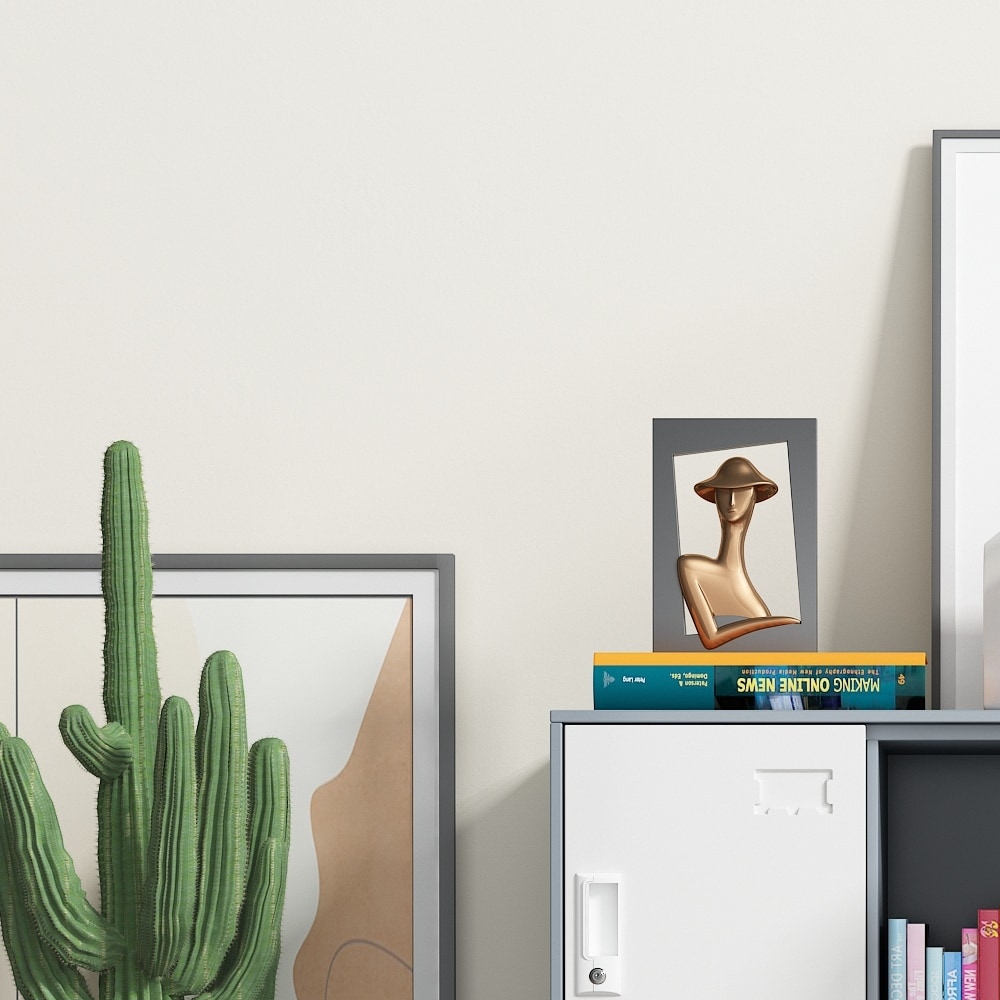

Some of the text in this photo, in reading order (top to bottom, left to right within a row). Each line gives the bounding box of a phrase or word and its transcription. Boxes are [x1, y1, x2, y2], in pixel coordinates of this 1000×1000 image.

[737, 678, 880, 692] MAKING ONLINE NEWS
